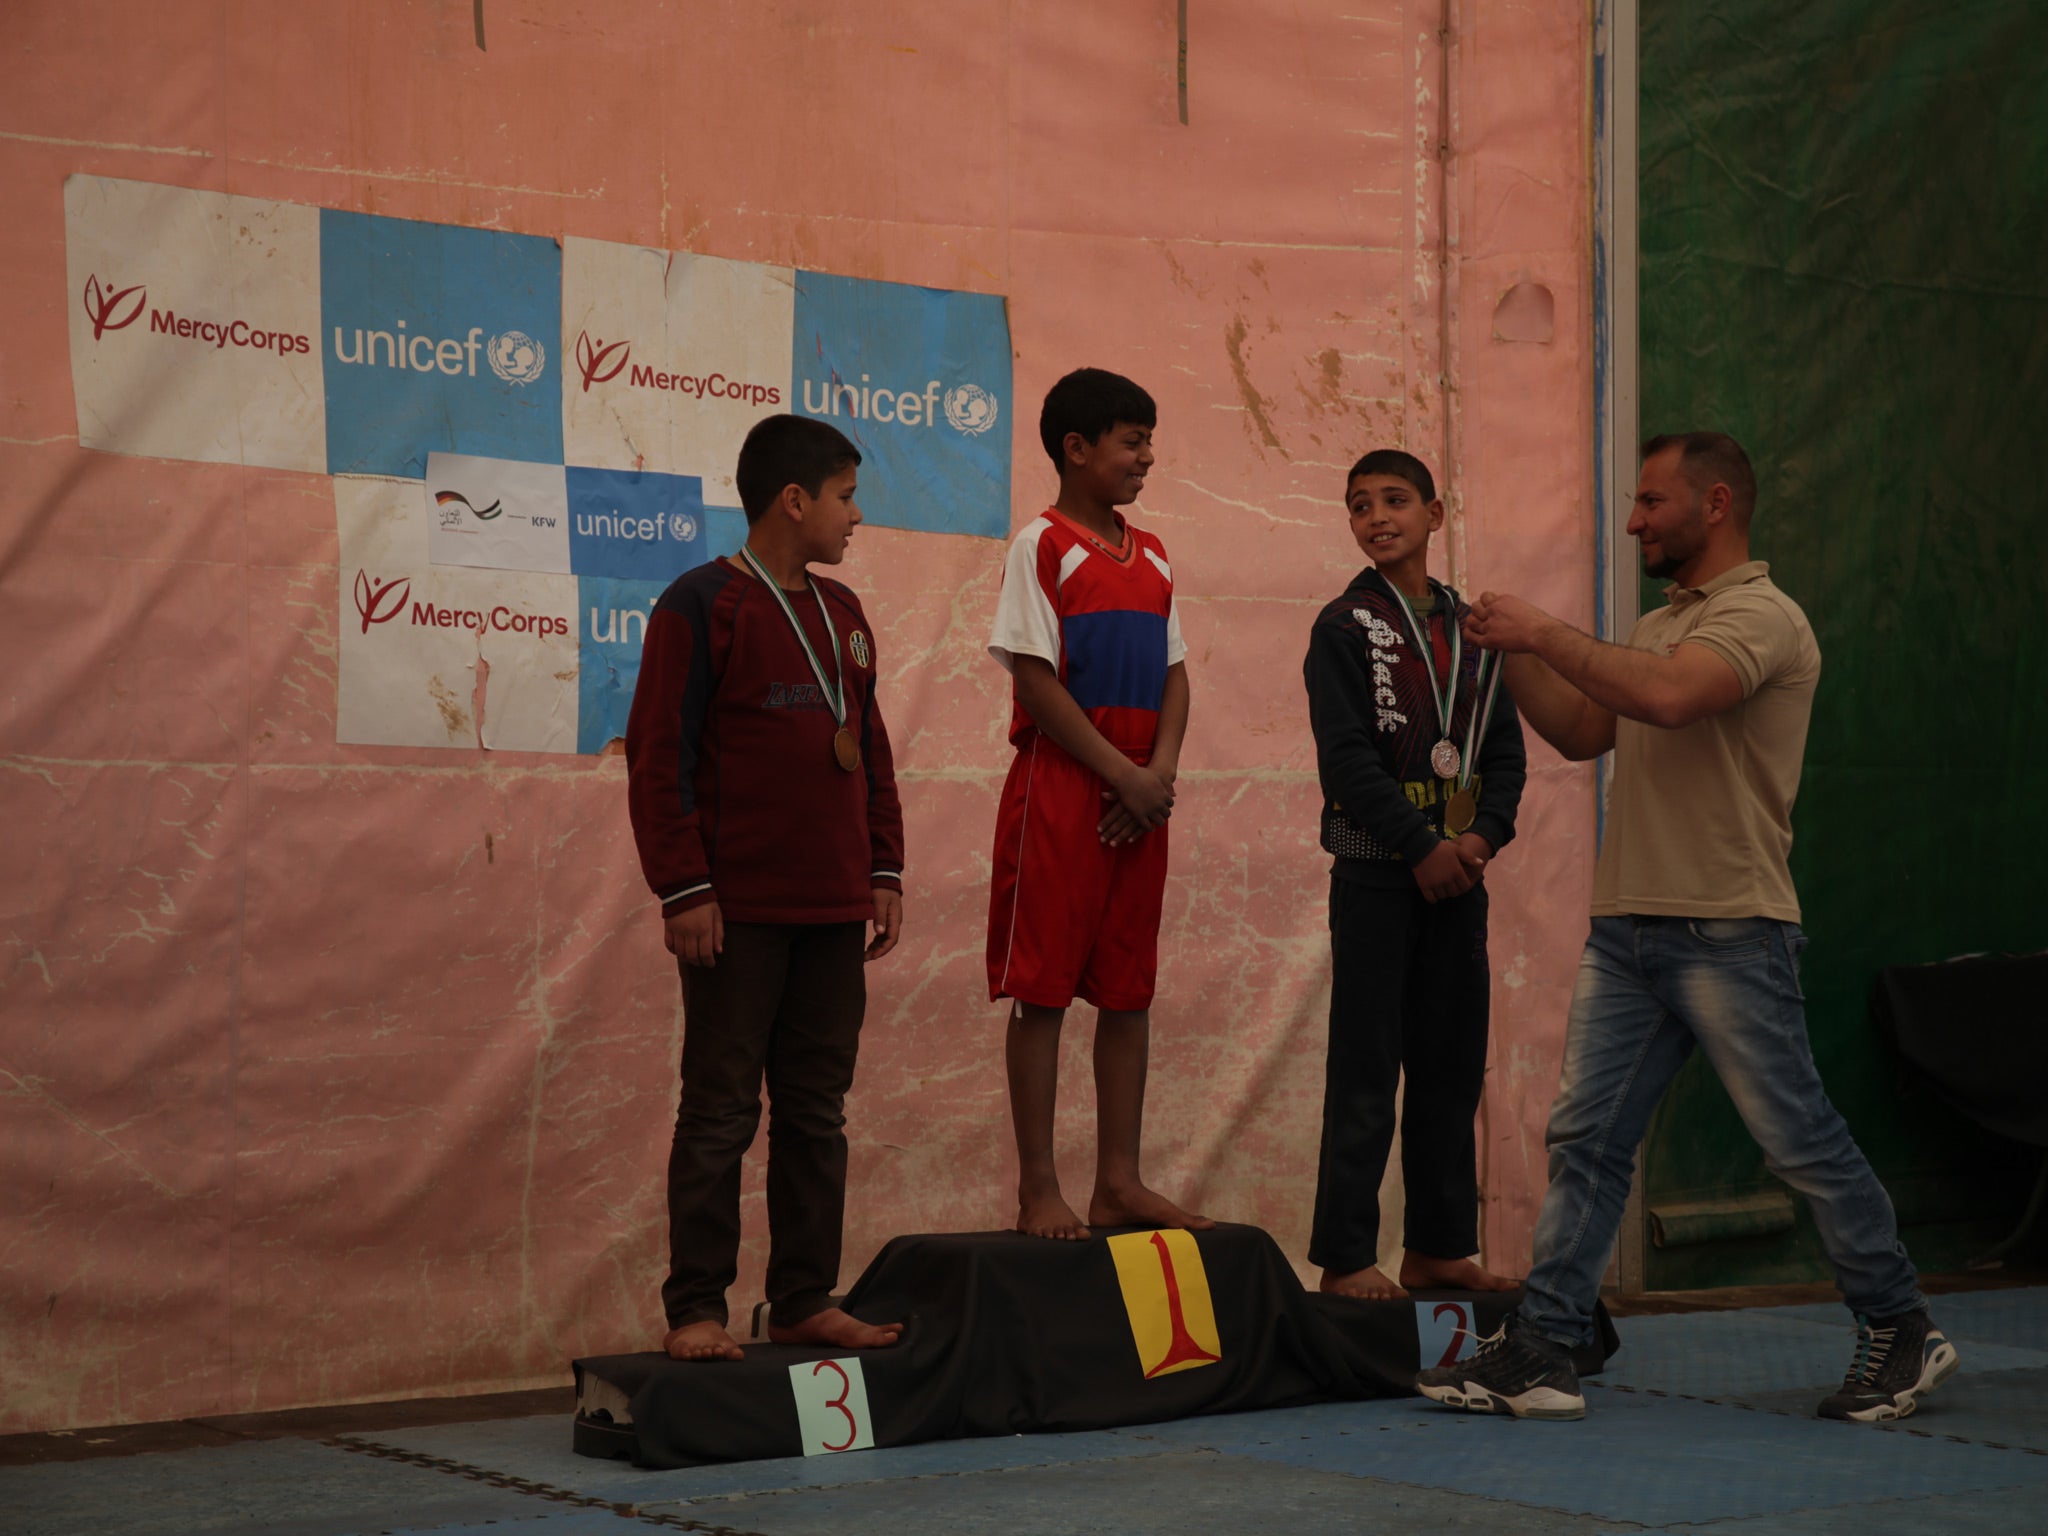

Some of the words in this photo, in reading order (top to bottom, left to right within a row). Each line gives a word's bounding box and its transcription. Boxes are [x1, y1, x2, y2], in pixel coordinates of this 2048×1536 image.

[150, 308, 310, 357] MercyCorps
[334, 319, 483, 377] unicef
[629, 364, 781, 407] MercyCorps
[803, 374, 940, 427] unicef
[576, 510, 665, 541] unicef
[411, 602, 569, 638] MercyCorps
[1146, 1231, 1222, 1379] 1
[1433, 1303, 1467, 1368] 2
[813, 1359, 857, 1452] 3
